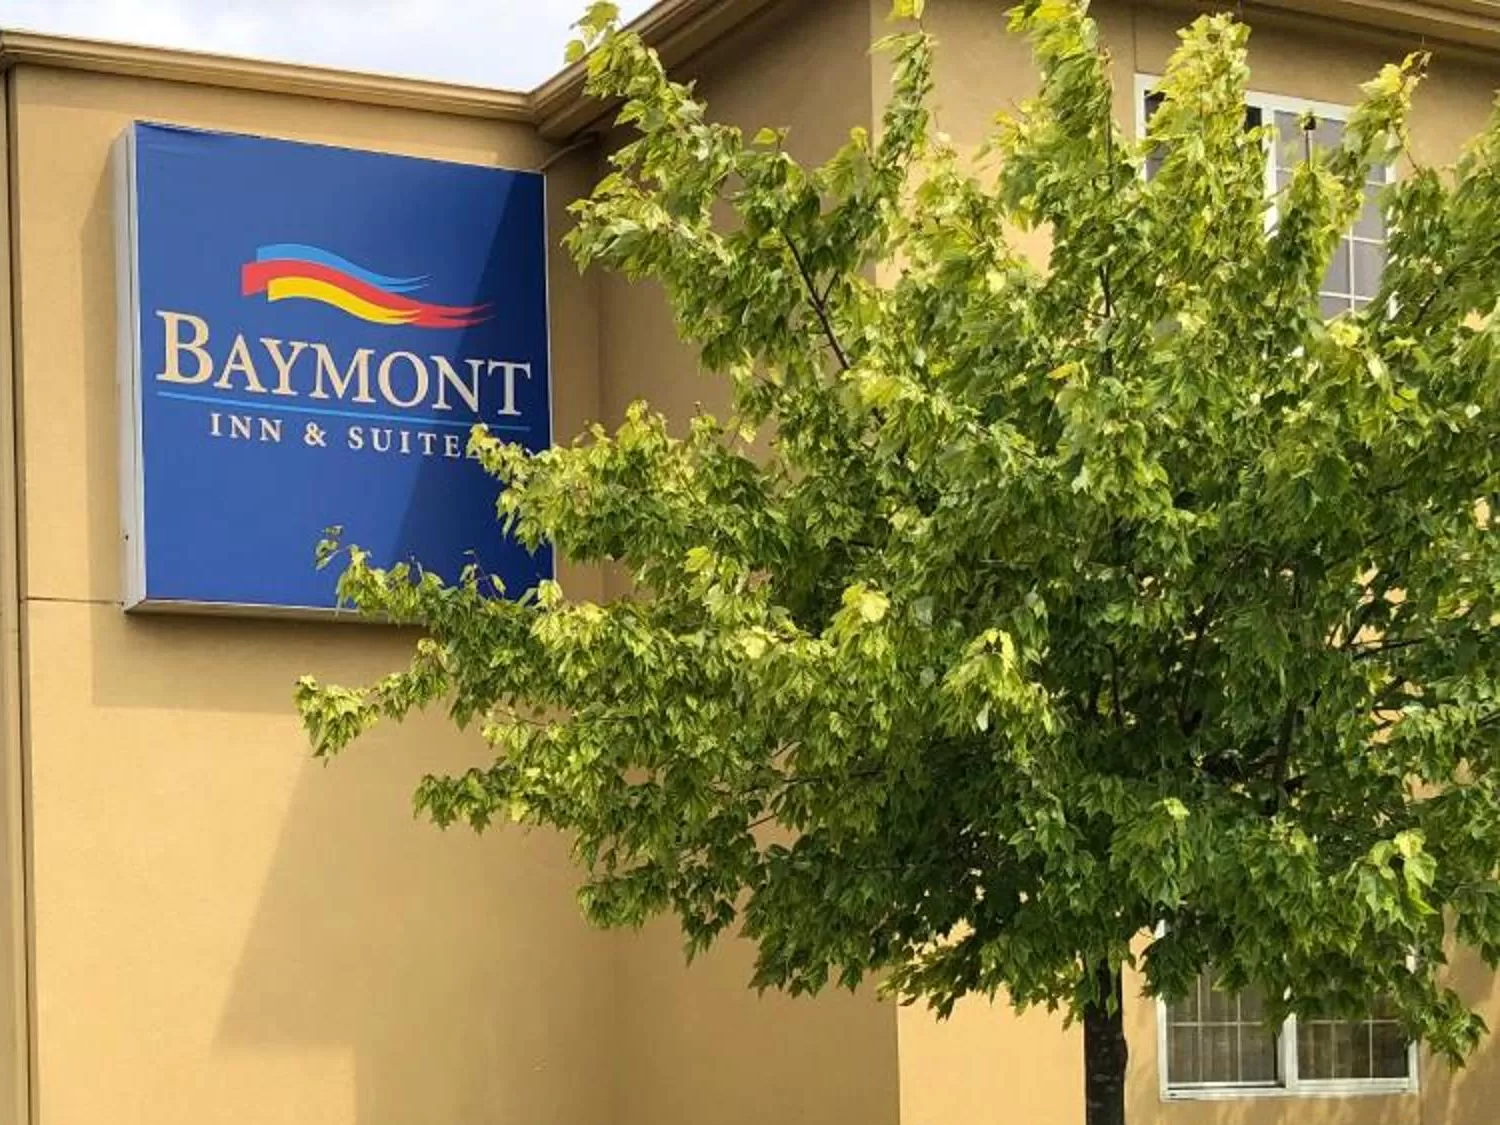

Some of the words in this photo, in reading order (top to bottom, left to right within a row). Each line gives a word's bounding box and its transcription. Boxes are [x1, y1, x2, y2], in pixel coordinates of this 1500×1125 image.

[156, 310, 531, 416] BAYMONT
[210, 412, 282, 442] INN
[303, 421, 327, 448] &
[348, 425, 483, 458] SUITE
